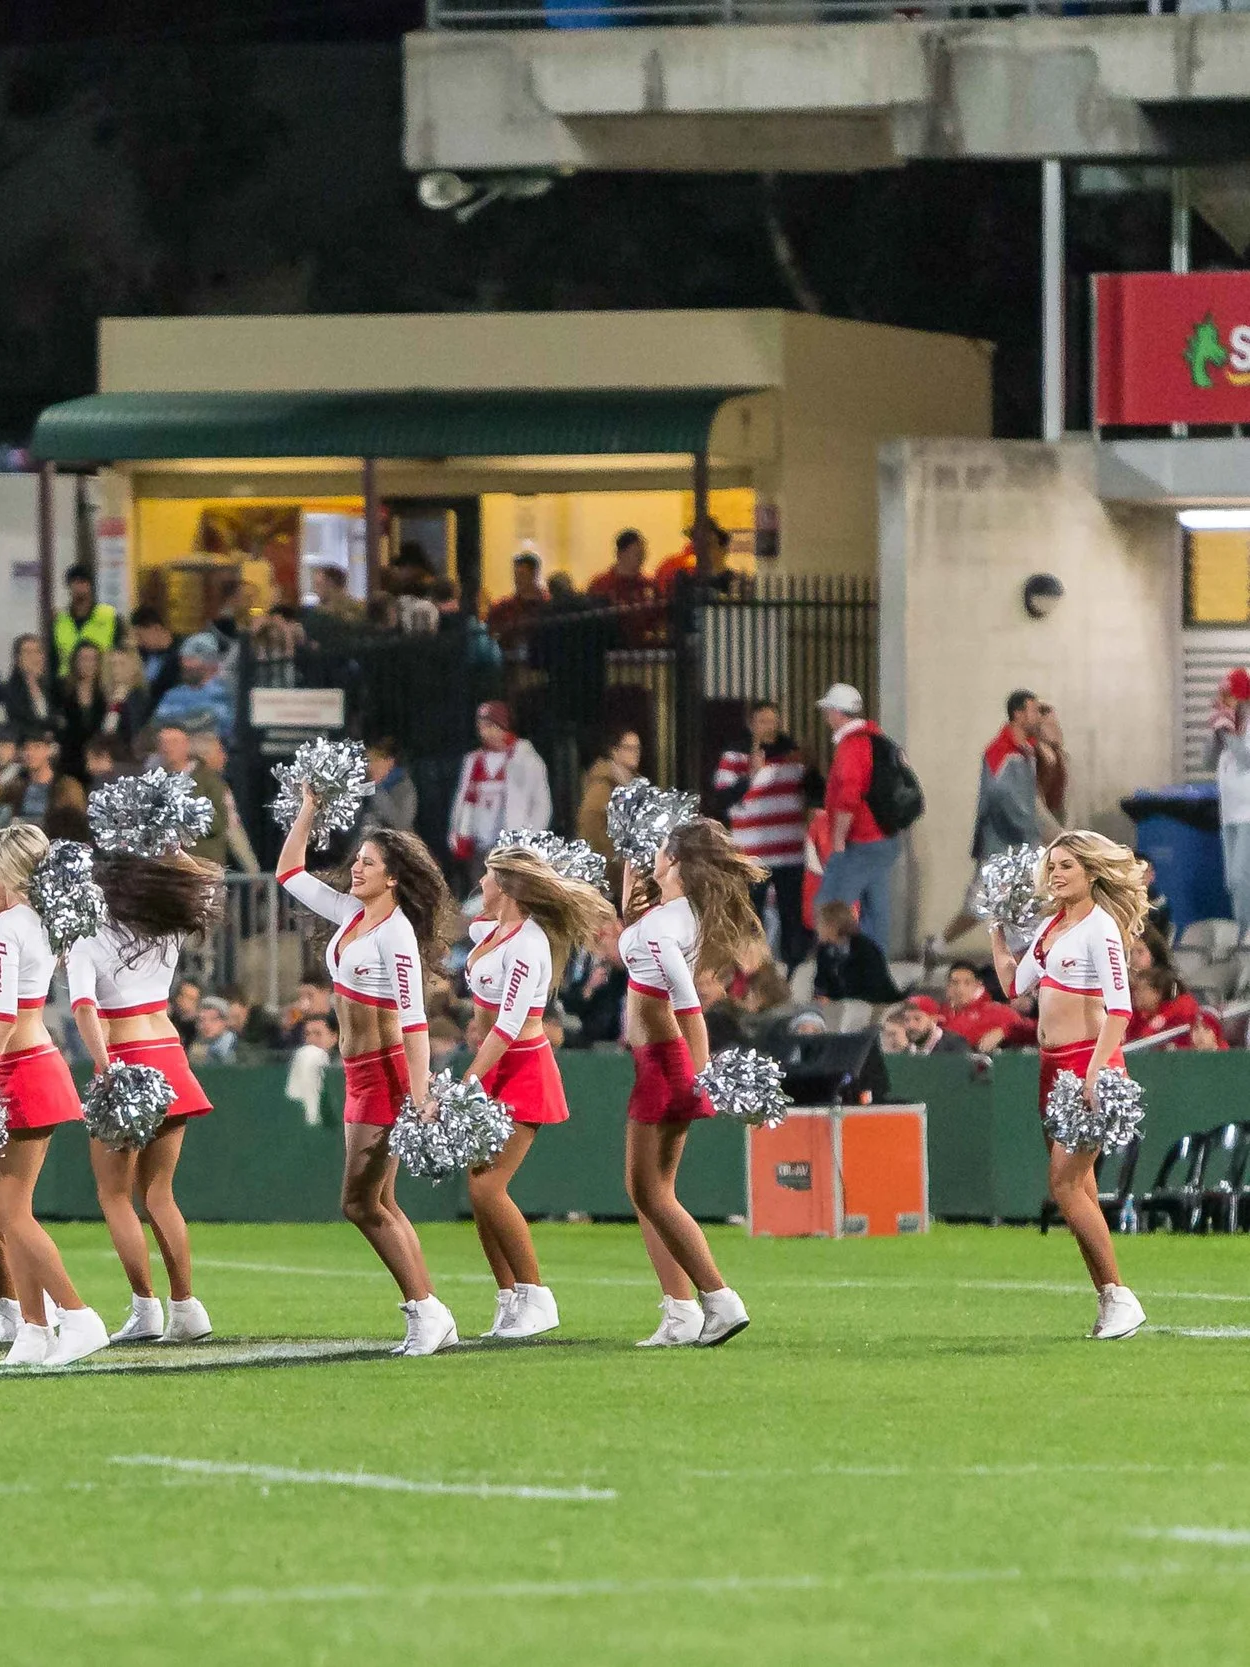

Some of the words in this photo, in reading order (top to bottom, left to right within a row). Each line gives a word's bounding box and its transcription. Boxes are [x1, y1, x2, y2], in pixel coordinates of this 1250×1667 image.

[395, 953, 413, 1010] Flames
[504, 959, 530, 1012] Flames
[1105, 938, 1125, 991] Flames
